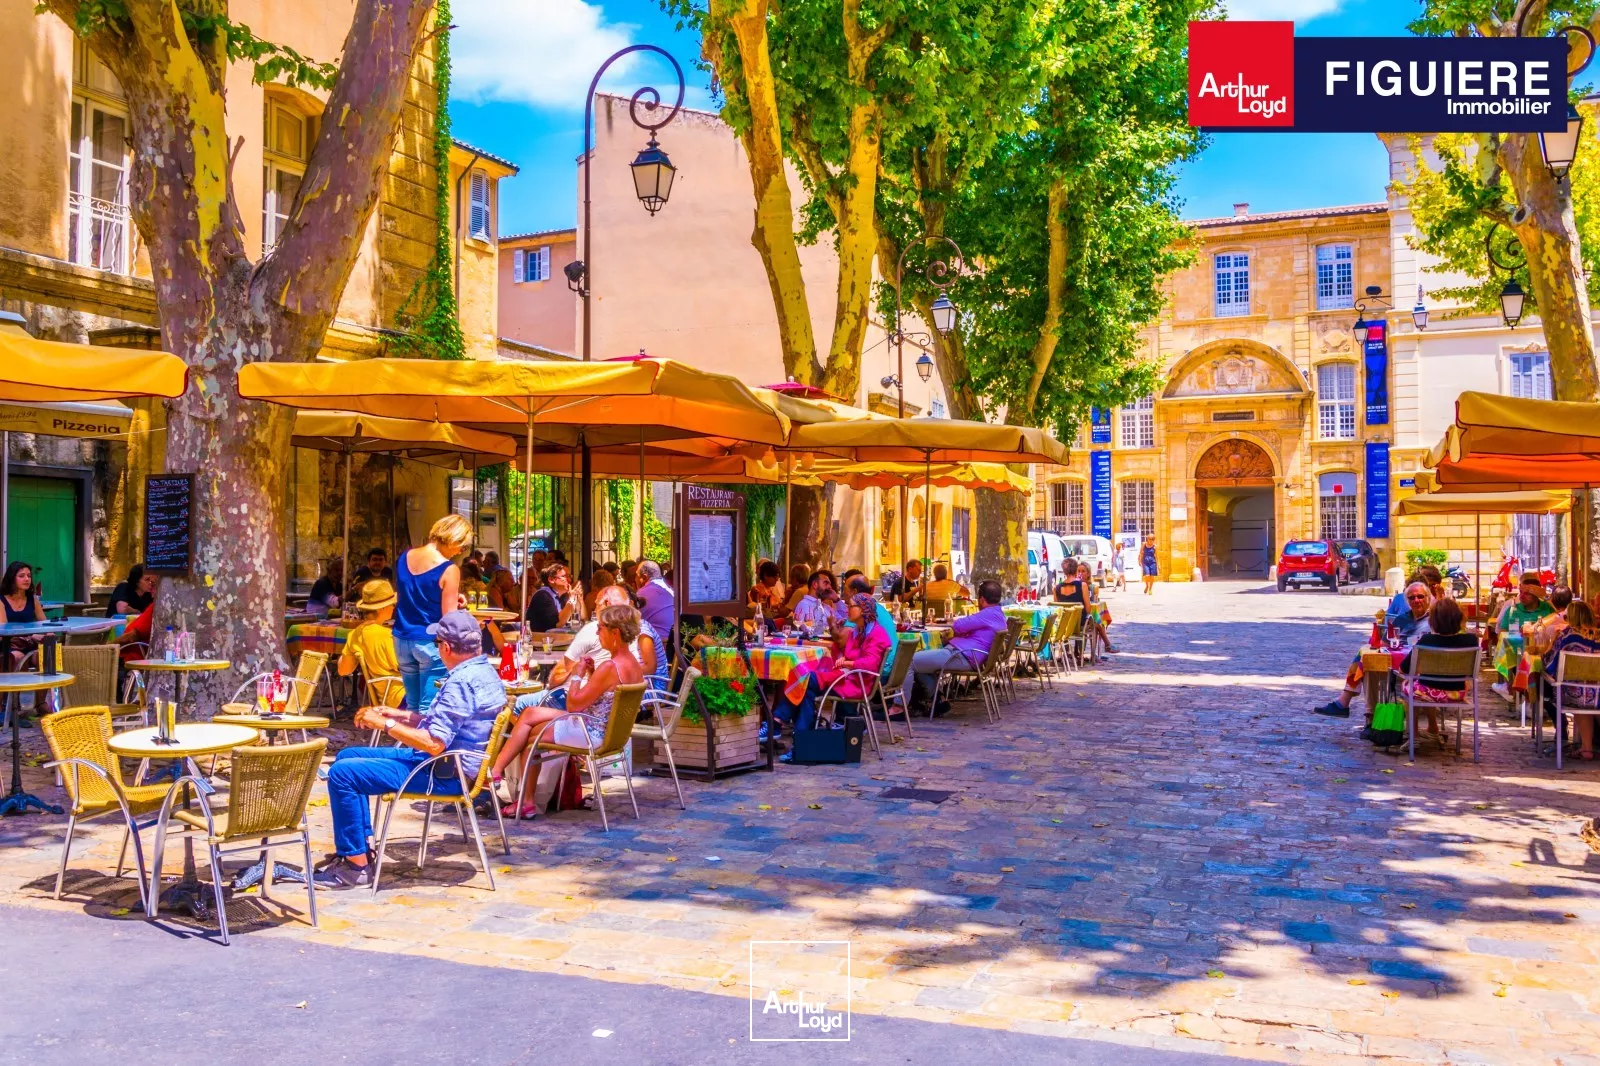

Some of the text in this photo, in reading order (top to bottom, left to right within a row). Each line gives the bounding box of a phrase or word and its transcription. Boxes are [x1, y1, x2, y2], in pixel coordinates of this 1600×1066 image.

[53, 418, 121, 434] Pizzeria
[688, 485, 735, 500] RESTAURANT
[700, 499, 731, 508] PIZZERIA
